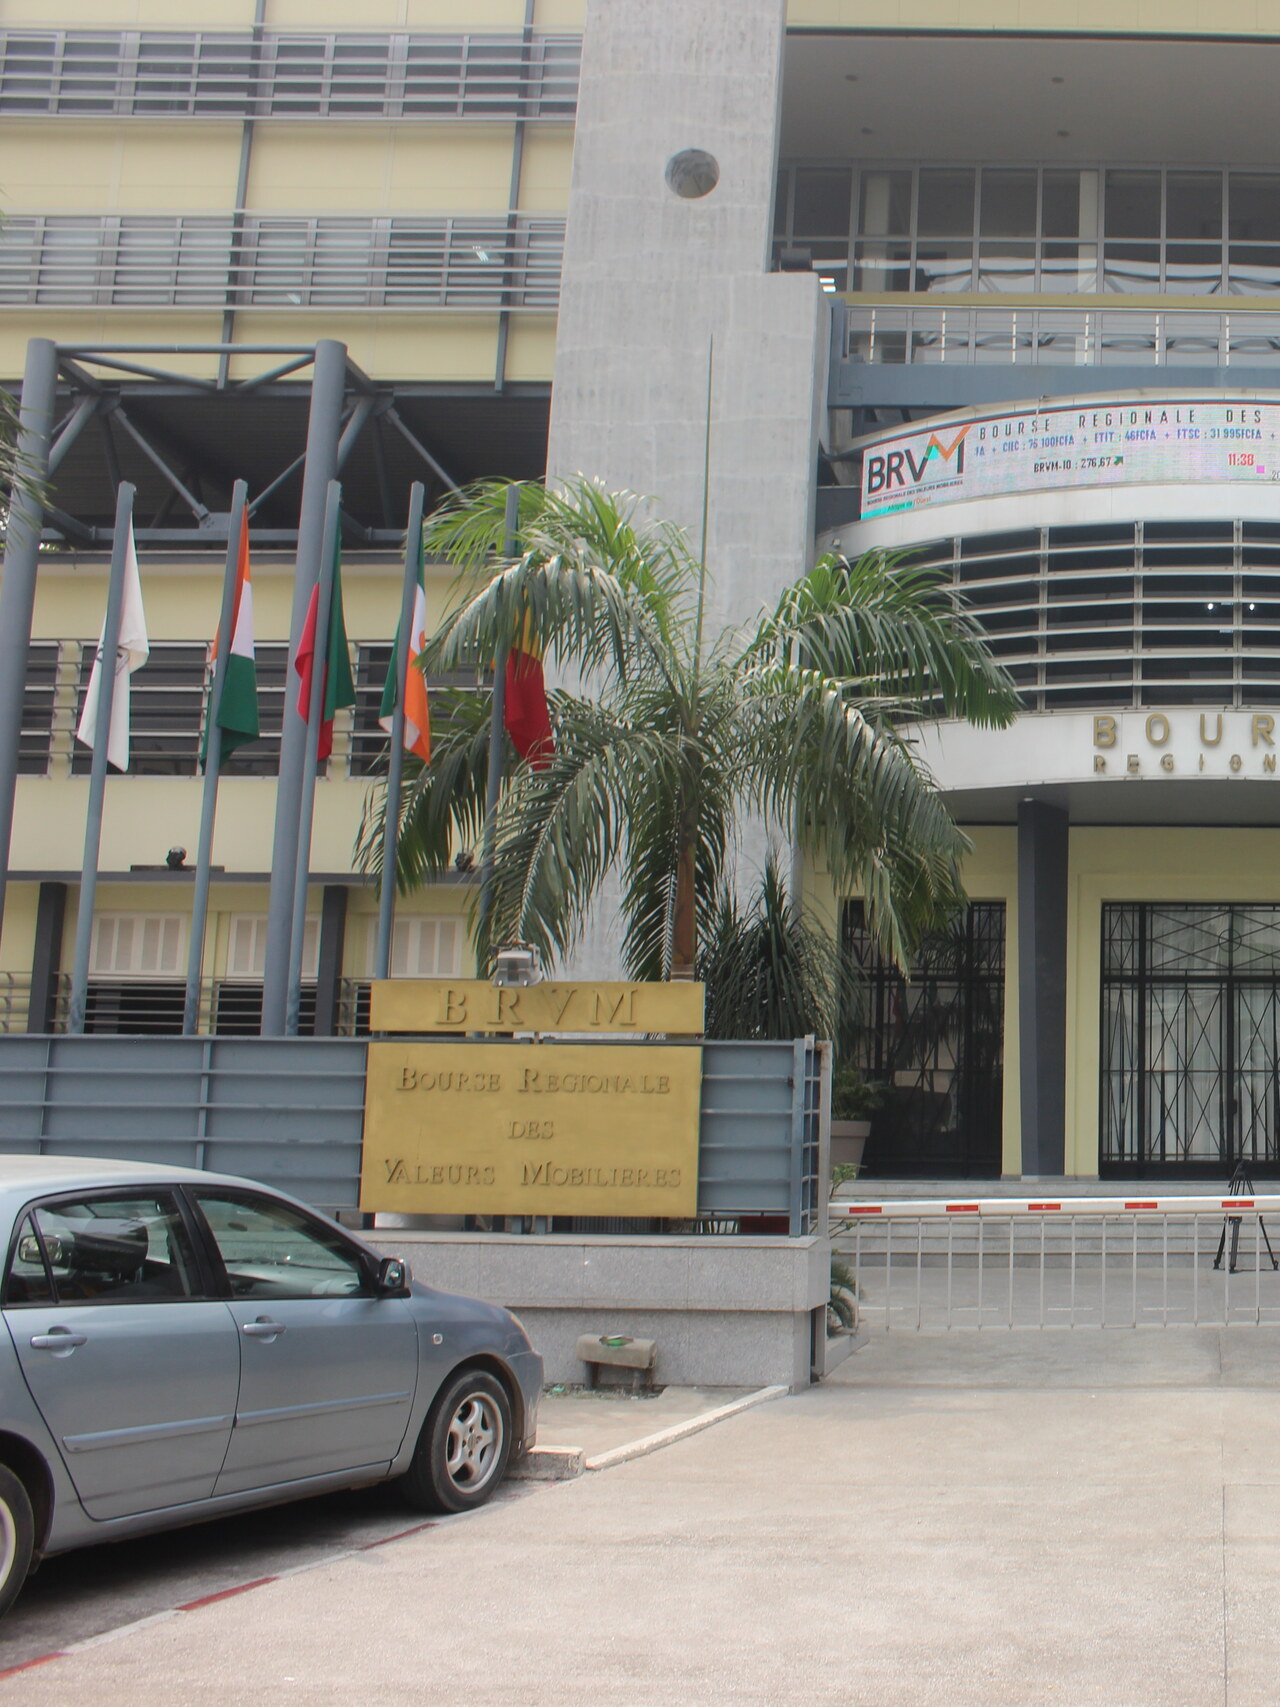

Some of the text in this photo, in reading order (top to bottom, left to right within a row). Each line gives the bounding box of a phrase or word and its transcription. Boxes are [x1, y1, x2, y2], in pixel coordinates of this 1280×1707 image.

[979, 418, 1051, 440] BOURSE
[1078, 409, 1196, 429] REGIONALE
[1226, 409, 1261, 424] DES
[867, 425, 972, 495] BRVM
[1081, 457, 1111, 470] 276,67
[1228, 453, 1254, 466] 11:38
[435, 986, 638, 1027] BRVM
[396, 1065, 671, 1095] BOURSE REGIONALE
[507, 1120, 555, 1140] DES
[384, 1159, 682, 1188] VALEURS MOBILIERES
